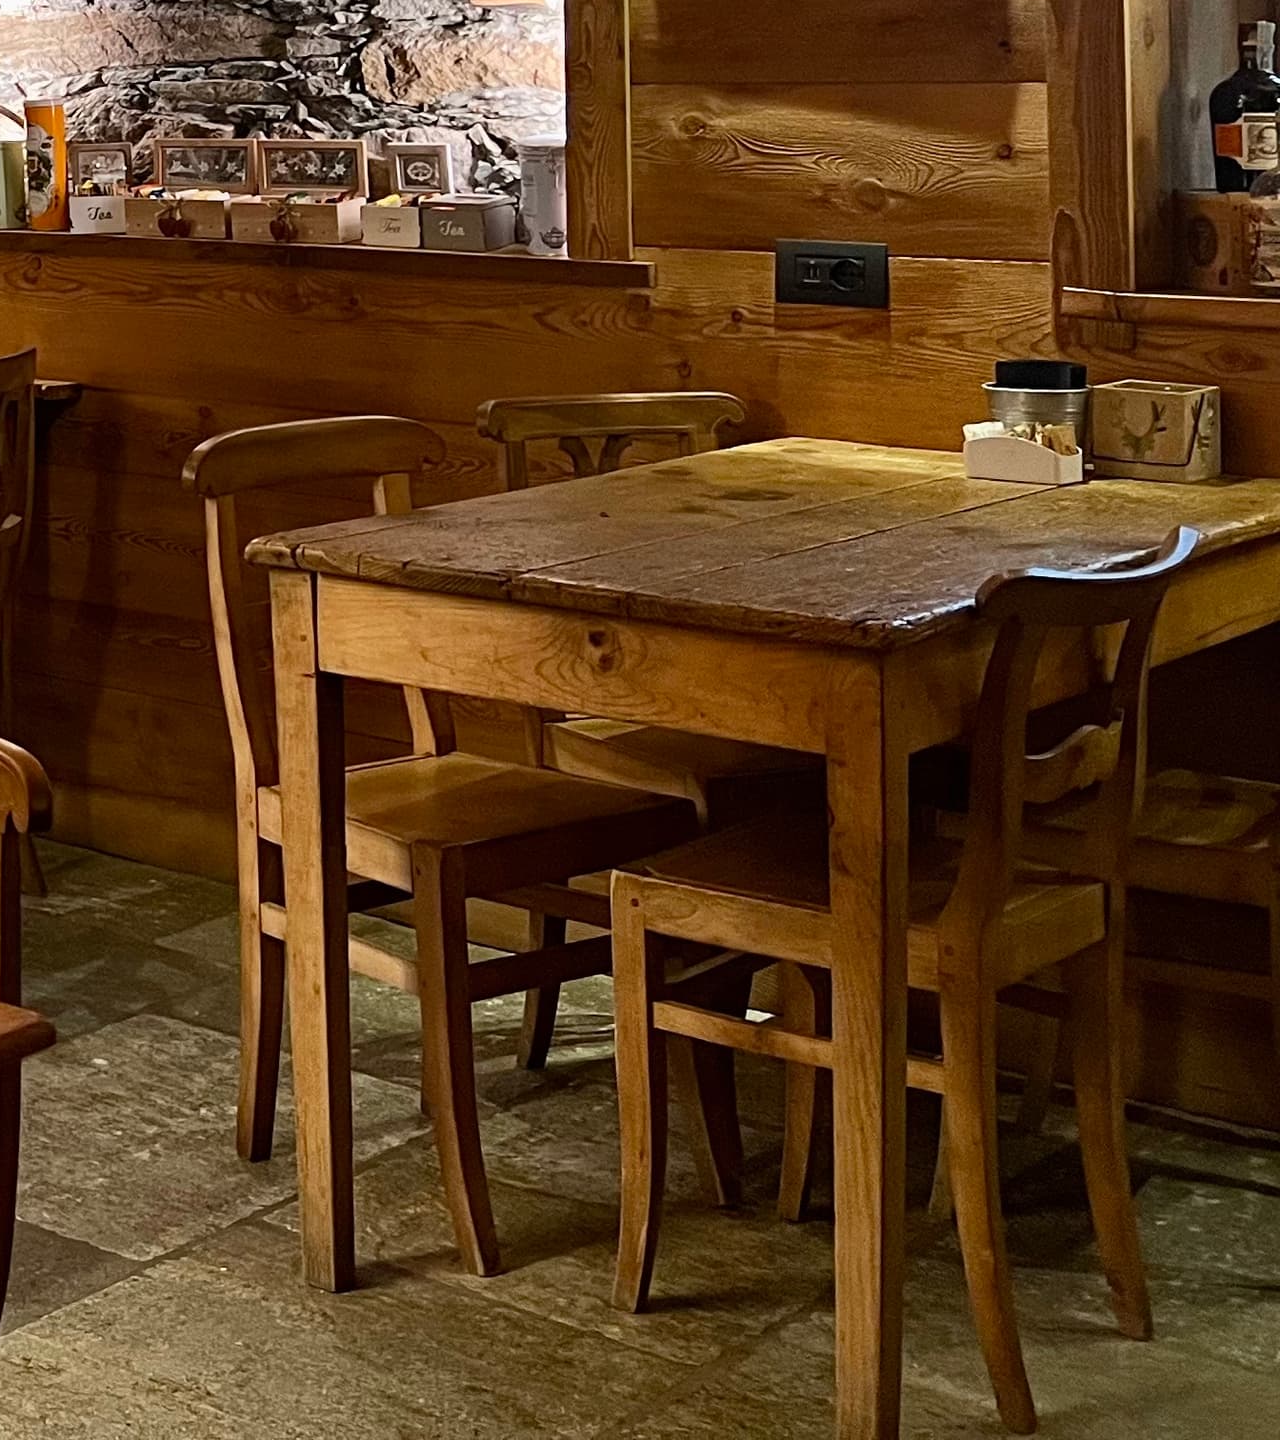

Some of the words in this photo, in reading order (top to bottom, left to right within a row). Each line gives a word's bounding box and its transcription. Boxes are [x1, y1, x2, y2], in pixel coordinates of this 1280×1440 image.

[87, 206, 114, 221] Tea
[379, 217, 402, 234] Tea
[438, 220, 465, 236] Tea
